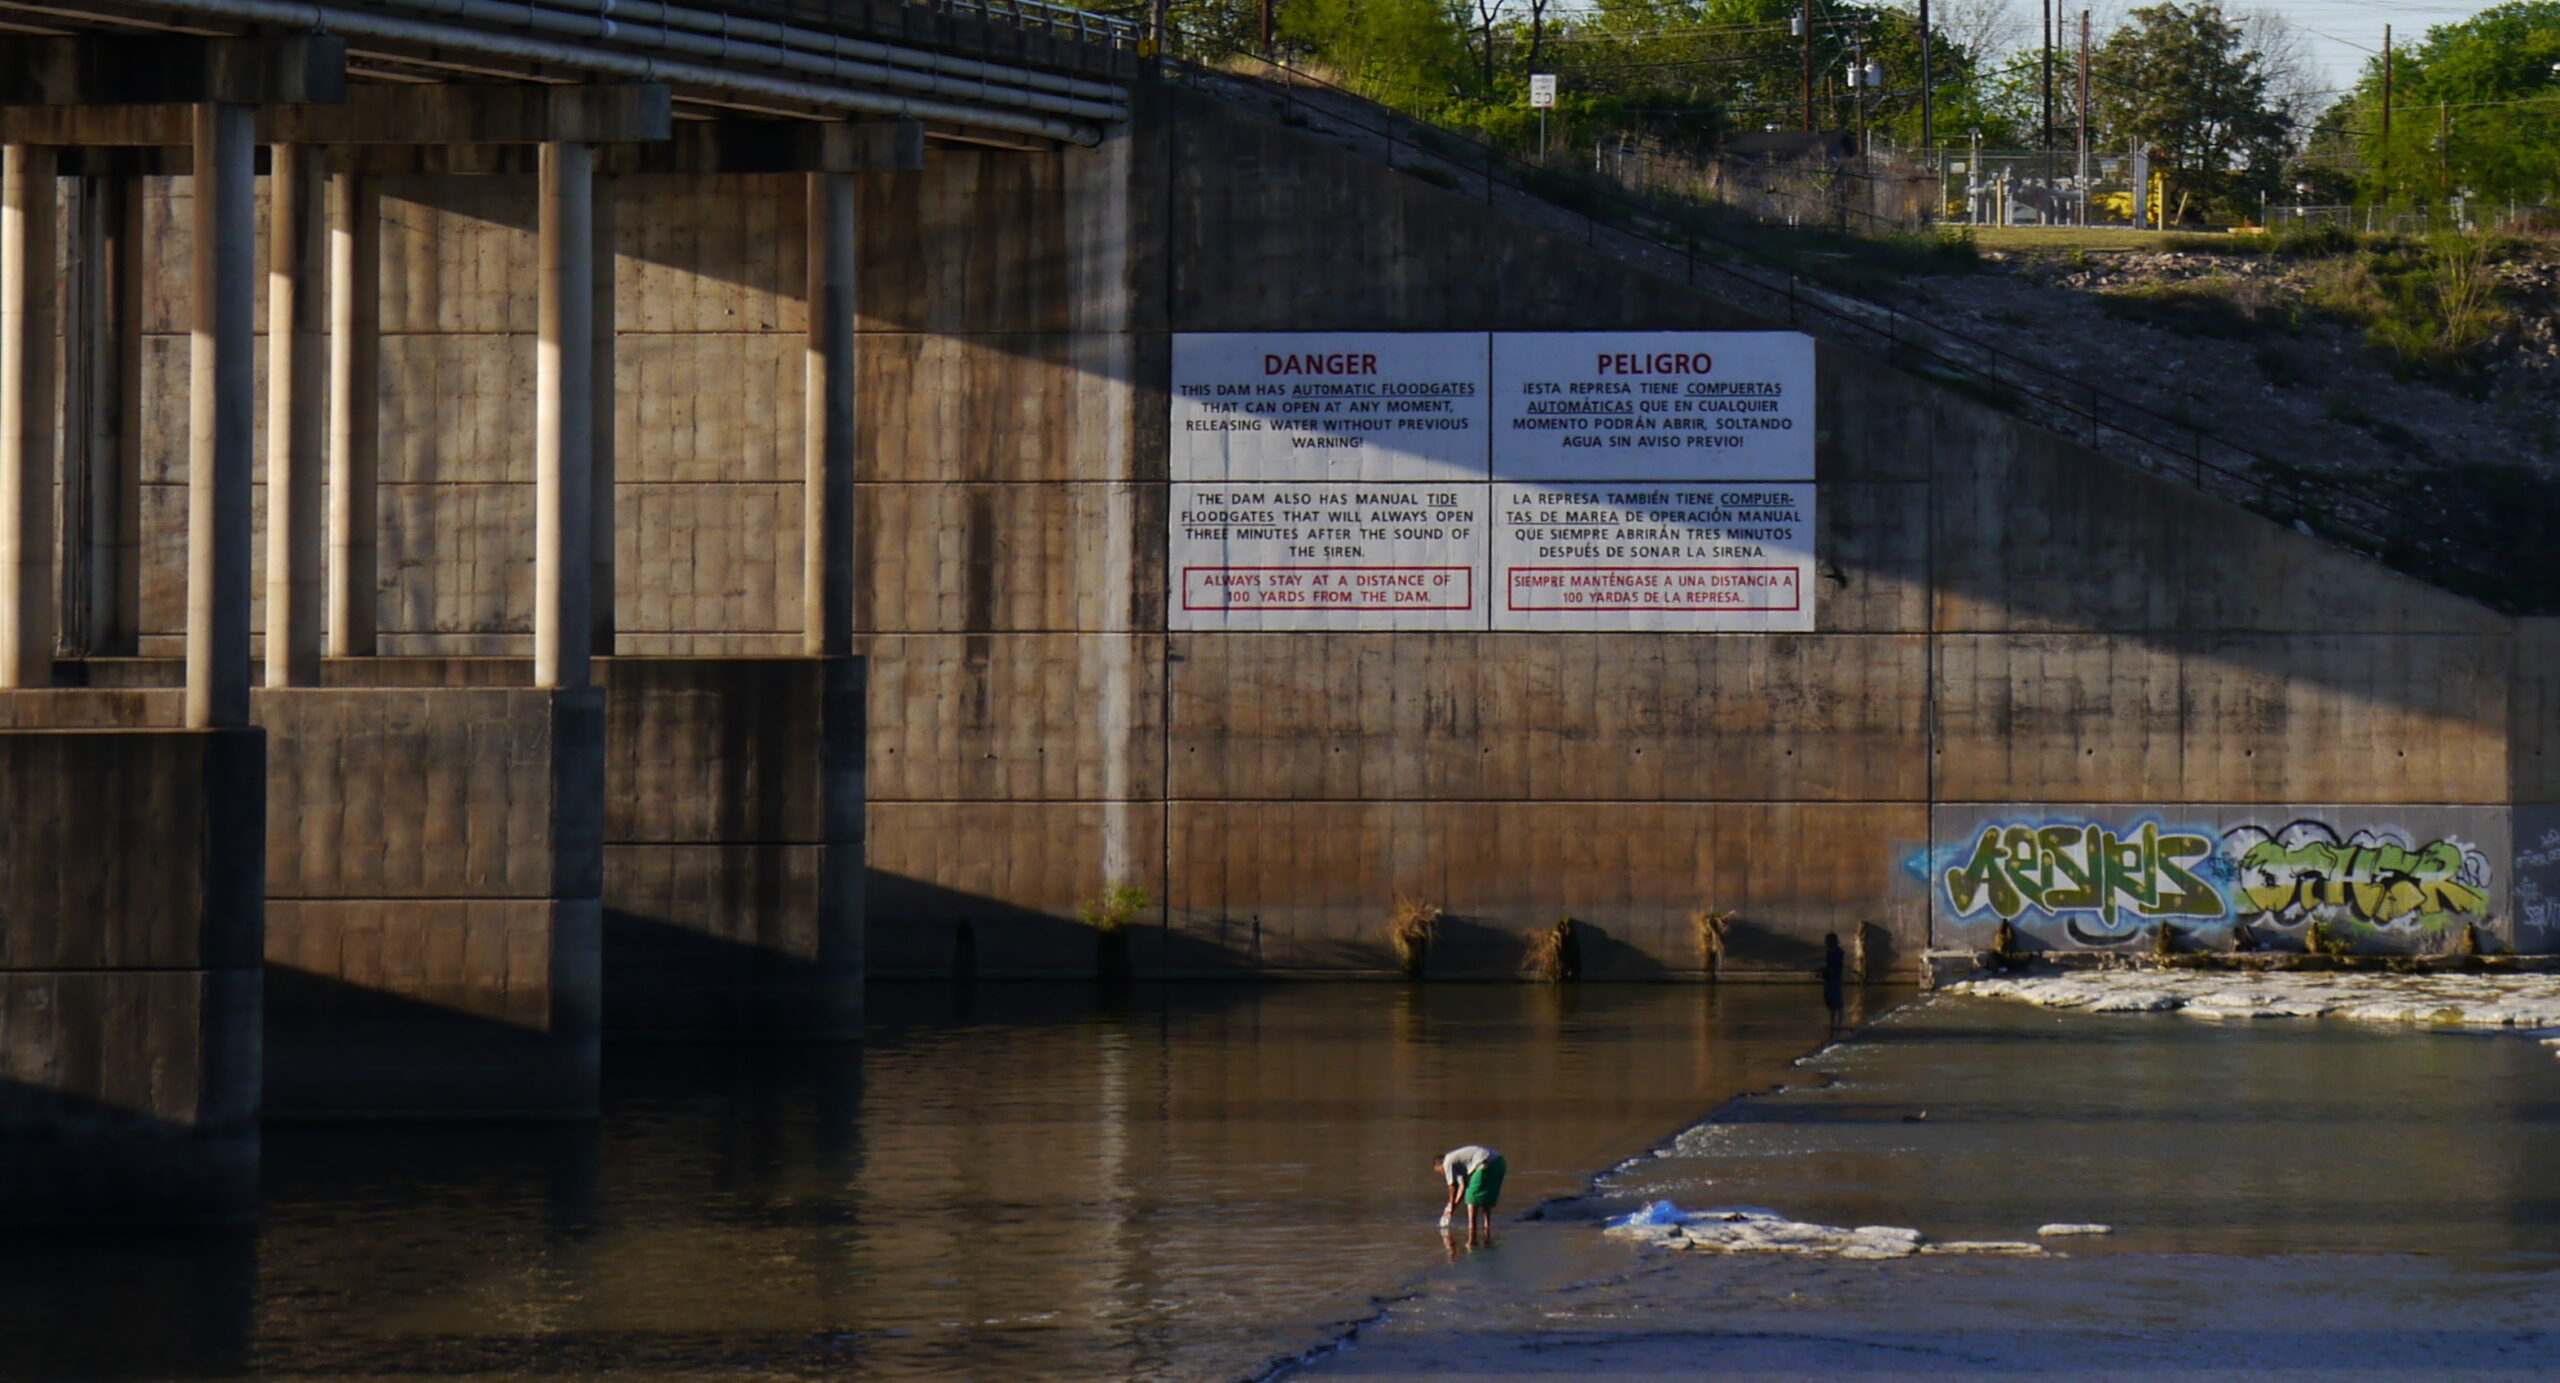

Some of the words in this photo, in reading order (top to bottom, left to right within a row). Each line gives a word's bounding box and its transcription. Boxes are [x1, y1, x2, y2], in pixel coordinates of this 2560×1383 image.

[1265, 354, 1377, 375] DANGER
[1598, 354, 1712, 375] PELIGRO
[1181, 384, 1210, 396] THIS
[1217, 384, 1250, 396] DAM
[1257, 384, 1285, 396] HAS
[1292, 384, 1376, 396] AUTOMATIC
[1382, 384, 1475, 396] FLOODGATES
[1570, 383, 1631, 394] REPRESA
[1641, 383, 1678, 394] TIENE
[1687, 383, 1781, 394] COMPUERTAS
[1202, 401, 1238, 413] THAT
[1246, 401, 1276, 413] CAN
[1284, 401, 1319, 413] OPEN
[1325, 401, 1342, 413] AT
[1350, 401, 1380, 413] ANY
[1387, 401, 1453, 413] MOMENT,
[1527, 398, 1633, 412] AUTOMÁTICAS
[1640, 401, 1668, 413] QUE
[1675, 401, 1692, 412] EN
[1699, 401, 1778, 413] CUALQUIER
[1186, 419, 1261, 430] RELEASING
[1270, 419, 1318, 430] WATER
[1324, 419, 1392, 430] WITHOUT
[1399, 419, 1468, 430] PREVIOUS
[1513, 418, 1588, 430] MOMENTO
[1595, 416, 1656, 430] PODRÁN
[1663, 418, 1708, 431] ABRIR,
[1717, 418, 1792, 430] SOLTANDO
[1292, 437, 1363, 448] WARNING!
[1562, 436, 1602, 447] AGUA
[1609, 436, 1631, 447] SIN
[1638, 436, 1680, 447] AVISO
[1687, 436, 1743, 447] PREVIO!
[1198, 494, 1223, 505] THE
[1232, 494, 1264, 505] DAM
[1274, 494, 1311, 505] ALSO
[1320, 494, 1347, 505] HAS
[1356, 494, 1418, 505] MANUAL
[1428, 494, 1457, 505] TIDE
[1513, 494, 1531, 504] LA
[1539, 494, 1599, 504] REPRESA
[1608, 490, 1669, 504] TAMBIÉN
[1677, 494, 1714, 504] TIENE
[1721, 494, 1794, 504] COMPUER-
[1182, 511, 1274, 522] FLOODGATES
[1284, 511, 1319, 522] THAT
[1328, 511, 1361, 522] WILL
[1371, 511, 1427, 522] ALWAYS
[1436, 511, 1473, 522] OPEN
[1508, 511, 1532, 522] TAS
[1541, 511, 1557, 522] DE
[1566, 511, 1618, 522] MAREA
[1626, 511, 1643, 522] DE
[1650, 508, 1732, 522] OPERACIÓN
[1738, 511, 1801, 522] MANUAL
[1185, 529, 1229, 540] THREE
[1237, 529, 1298, 540] MINUTES
[1308, 529, 1351, 540] AFTER
[1360, 529, 1386, 540] THE
[1395, 529, 1443, 540] SOUND
[1452, 529, 1470, 540] OF
[1515, 529, 1543, 541] QUE
[1550, 529, 1609, 540] SIEMPRE
[1616, 525, 1680, 540] ABRIRÁN
[1687, 529, 1720, 540] TRES
[1727, 529, 1792, 540] MINUTOS
[1290, 546, 1315, 557] THE
[1324, 546, 1365, 557] SIREN.
[1540, 542, 1600, 557] DESPUÉS
[1607, 546, 1624, 557] DE
[1631, 546, 1680, 557] SONAR
[1687, 546, 1705, 557] LA
[1204, 575, 1260, 586] ALWAYS
[1269, 575, 1303, 586] STAY
[1313, 575, 1329, 586] AT
[1338, 575, 1348, 586] A
[1357, 575, 1425, 586] DISTANCE
[1433, 575, 1451, 586] OF
[1514, 576, 1565, 587] SIEMPRE
[1571, 572, 1658, 587] MANTÉNGASE
[1664, 576, 1673, 587] A
[1679, 576, 1705, 587] UNA
[1711, 576, 1777, 587] DISTANCIA
[1783, 576, 1792, 587] A
[1227, 592, 1250, 602] 100
[1259, 592, 1304, 602] YARDS
[1314, 592, 1352, 602] FROM
[1362, 592, 1386, 602] THE
[1395, 592, 1430, 602] DAM.
[1563, 592, 1583, 603] 100
[1590, 592, 1639, 603] YARDAS
[1644, 592, 1659, 603] DE
[1665, 592, 1680, 603] LA
[1687, 592, 1744, 603] REPRESA.
